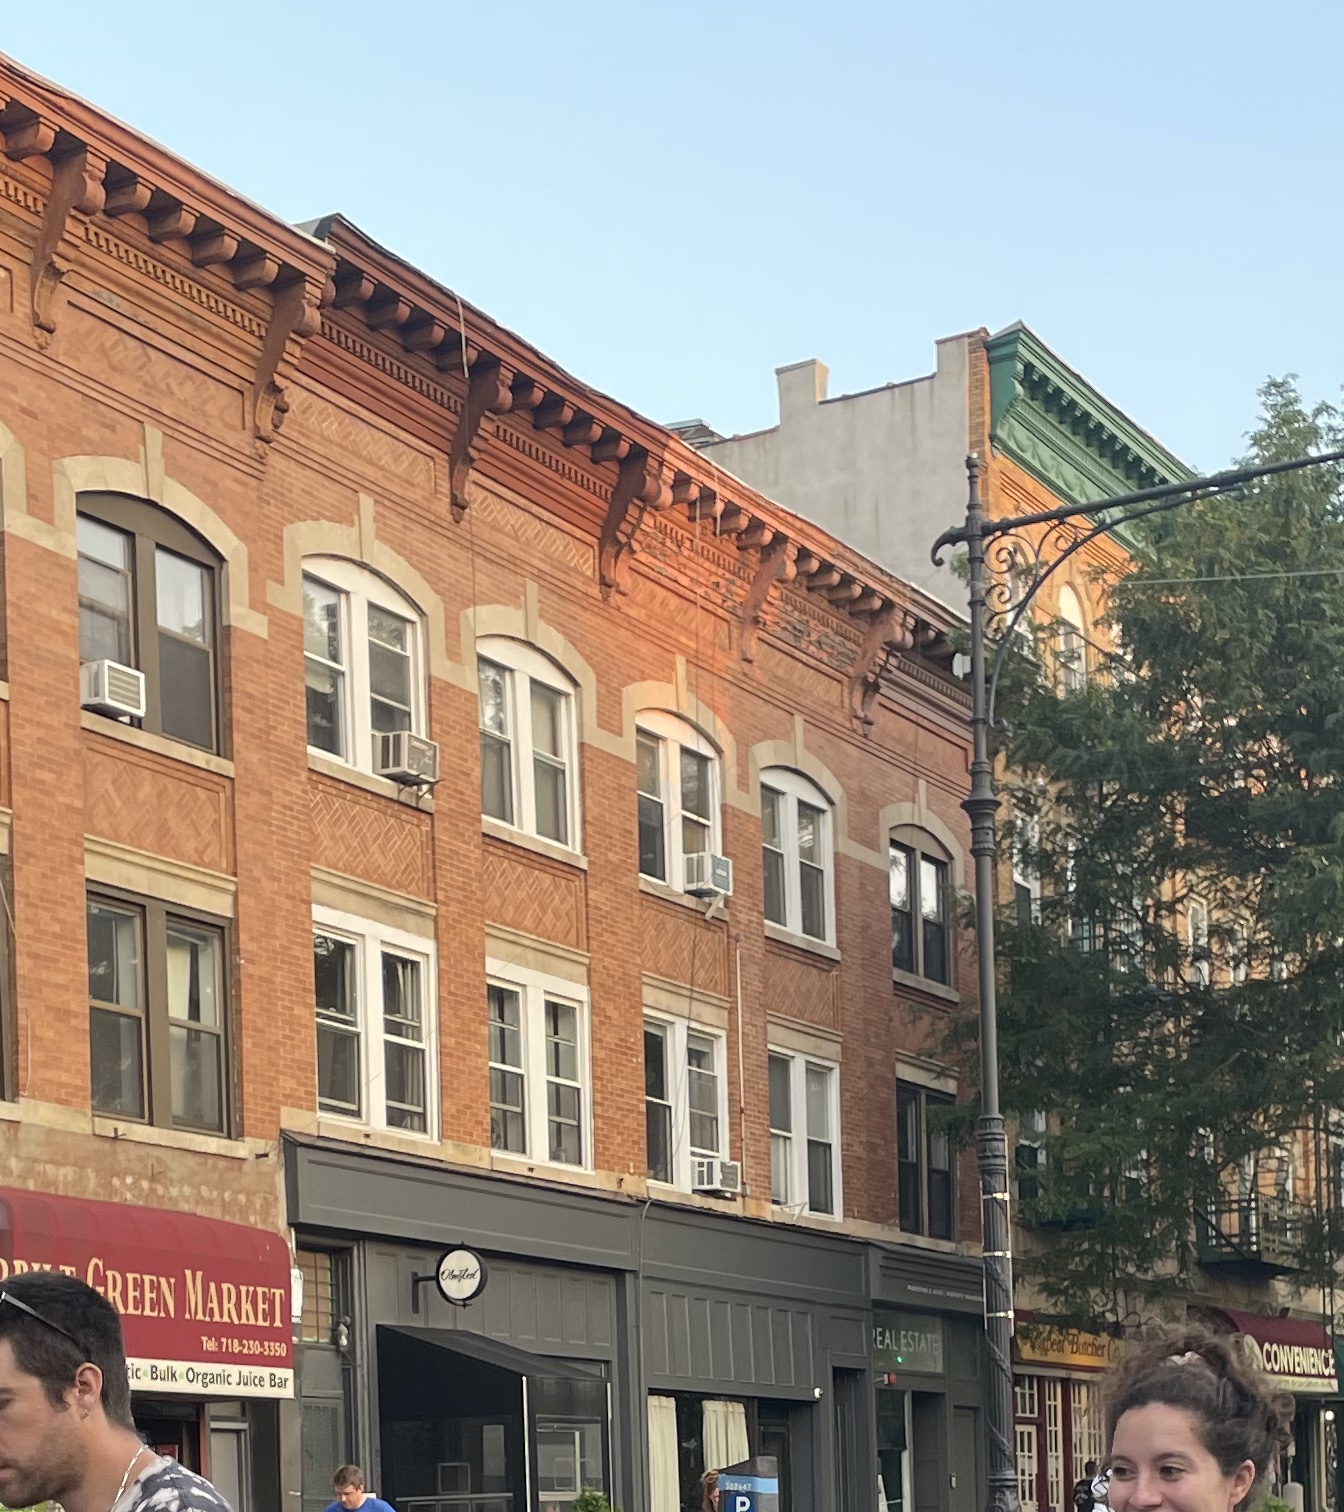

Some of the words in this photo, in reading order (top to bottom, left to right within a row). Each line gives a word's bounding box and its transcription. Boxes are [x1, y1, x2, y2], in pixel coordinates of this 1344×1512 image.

[86, 1257, 176, 1318] GREEN
[184, 1269, 285, 1328] MARKET
[221, 1337, 287, 1357] 718-230-3350
[900, 1331, 939, 1355] ESTATE
[1262, 1342, 1336, 1377] CONVENIENCE
[150, 1364, 178, 1383] Bulk
[186, 1367, 231, 1388] Organic
[235, 1370, 265, 1387] Juice
[269, 1373, 289, 1390] Bar
